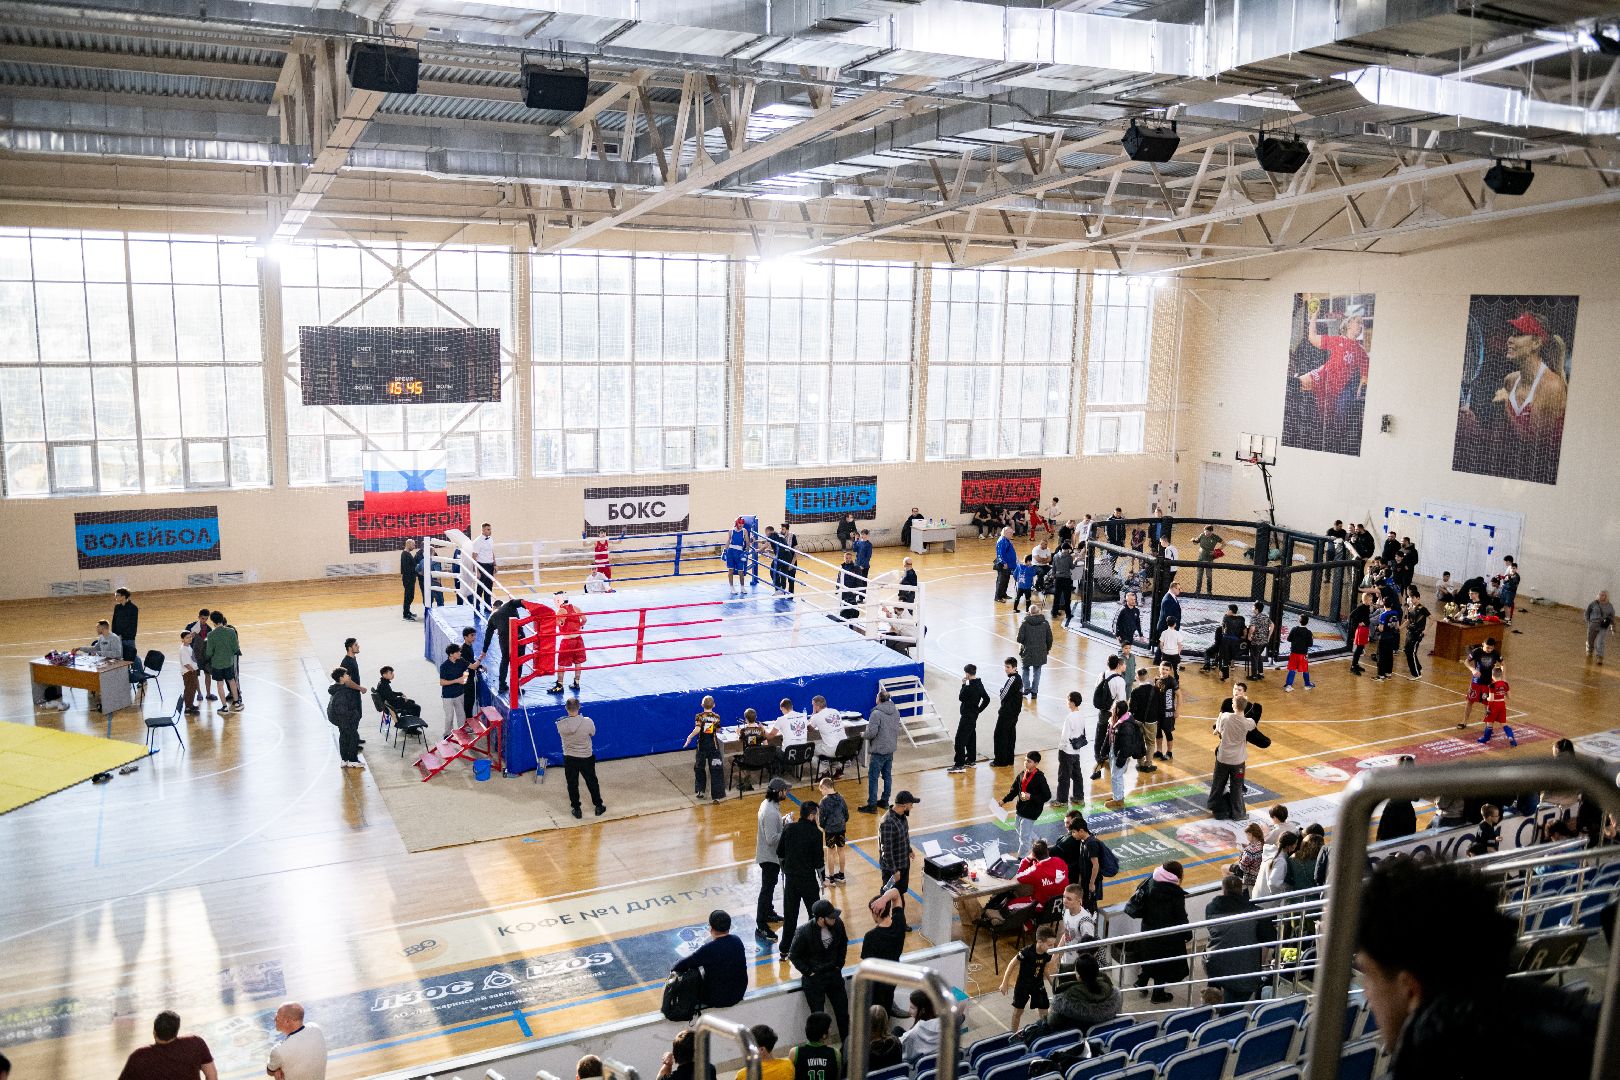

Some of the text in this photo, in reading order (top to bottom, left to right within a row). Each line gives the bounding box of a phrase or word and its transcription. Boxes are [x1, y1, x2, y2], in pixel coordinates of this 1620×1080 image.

[793, 489, 870, 510] ТЕННИС
[608, 501, 666, 520] БОКС
[358, 511, 463, 530] БАСКЕТБОЛ
[84, 527, 212, 551] ВОЛЕЙБОЛ
[498, 914, 575, 937] КОФЕ
[579, 904, 620, 921] №1
[626, 894, 677, 914] ДЛЯ
[807, 1057, 828, 1067] IRVING
[807, 1069, 825, 1080] 11
